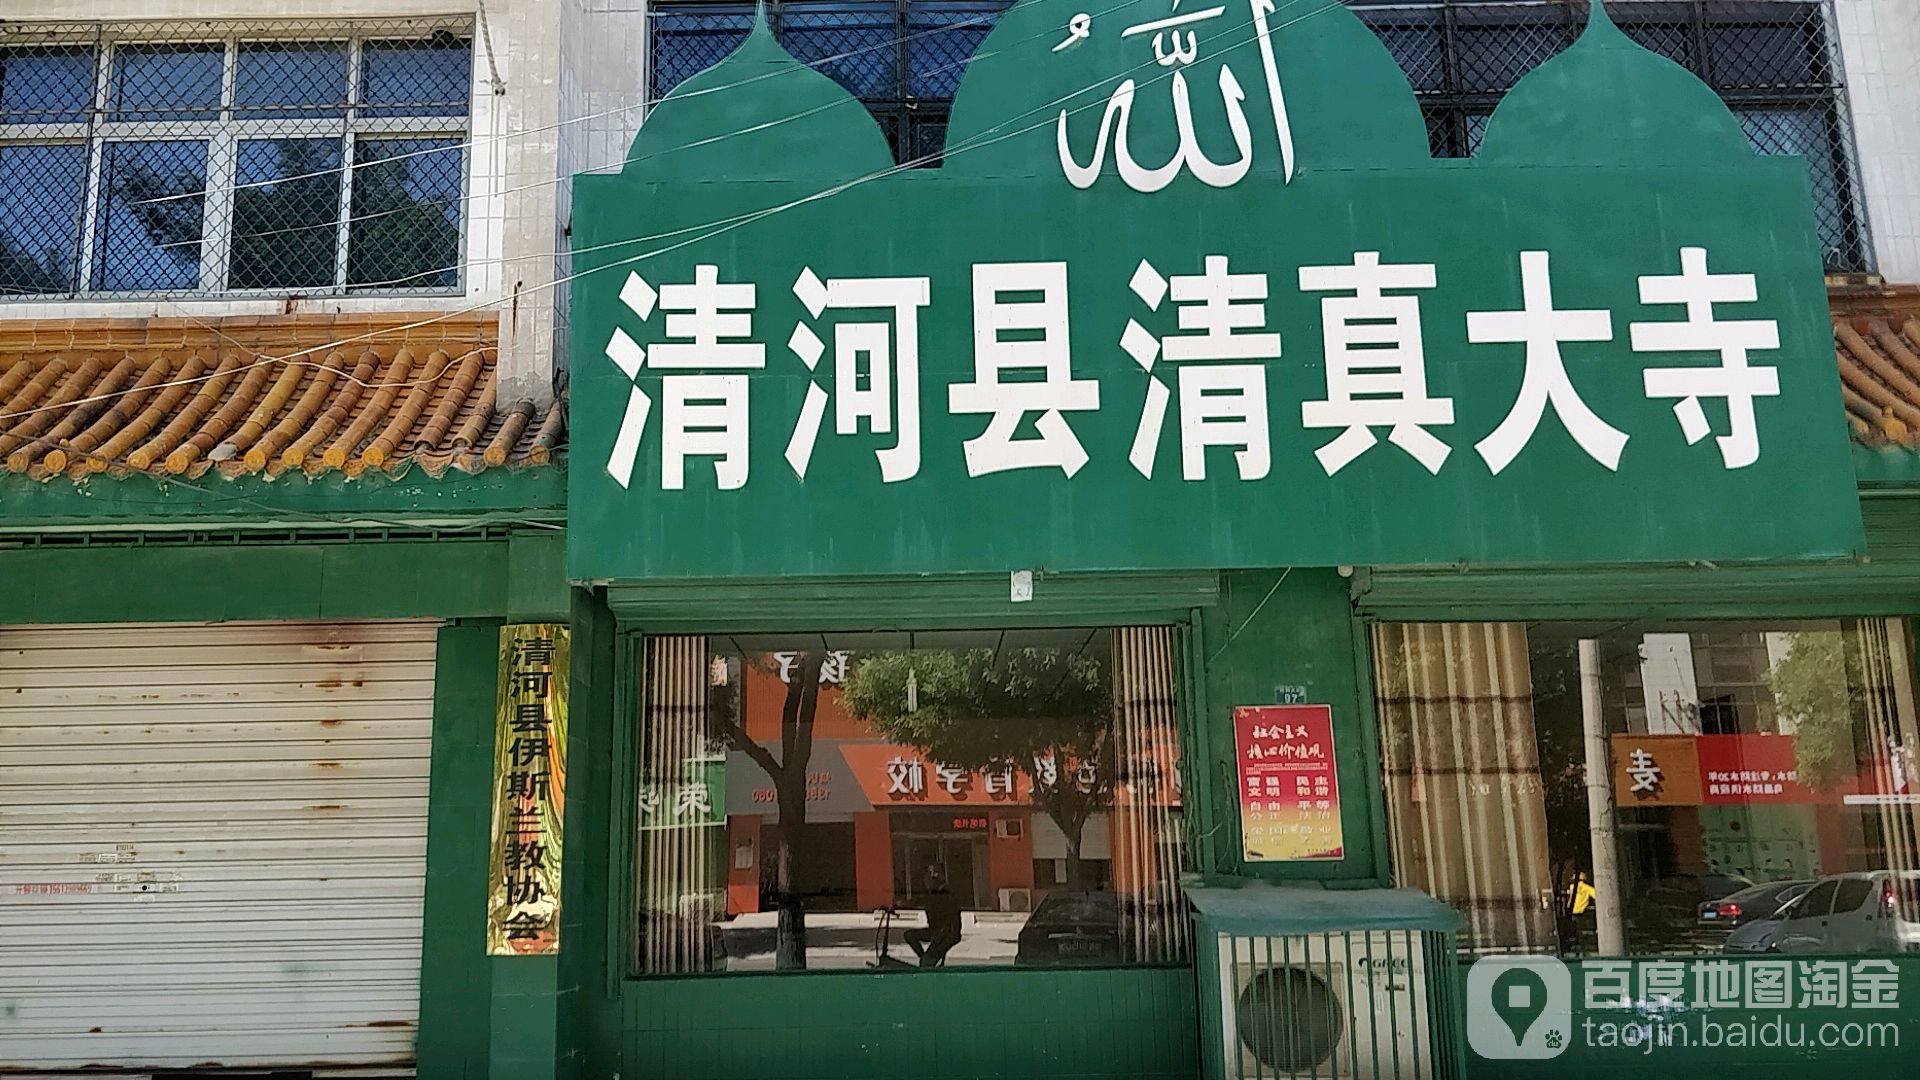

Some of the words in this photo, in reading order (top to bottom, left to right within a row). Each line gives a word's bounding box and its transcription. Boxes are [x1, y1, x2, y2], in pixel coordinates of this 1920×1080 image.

[606, 247, 1779, 489] 清河县清真大寺
[502, 637, 556, 941] 清河县伊斯兰教协会
